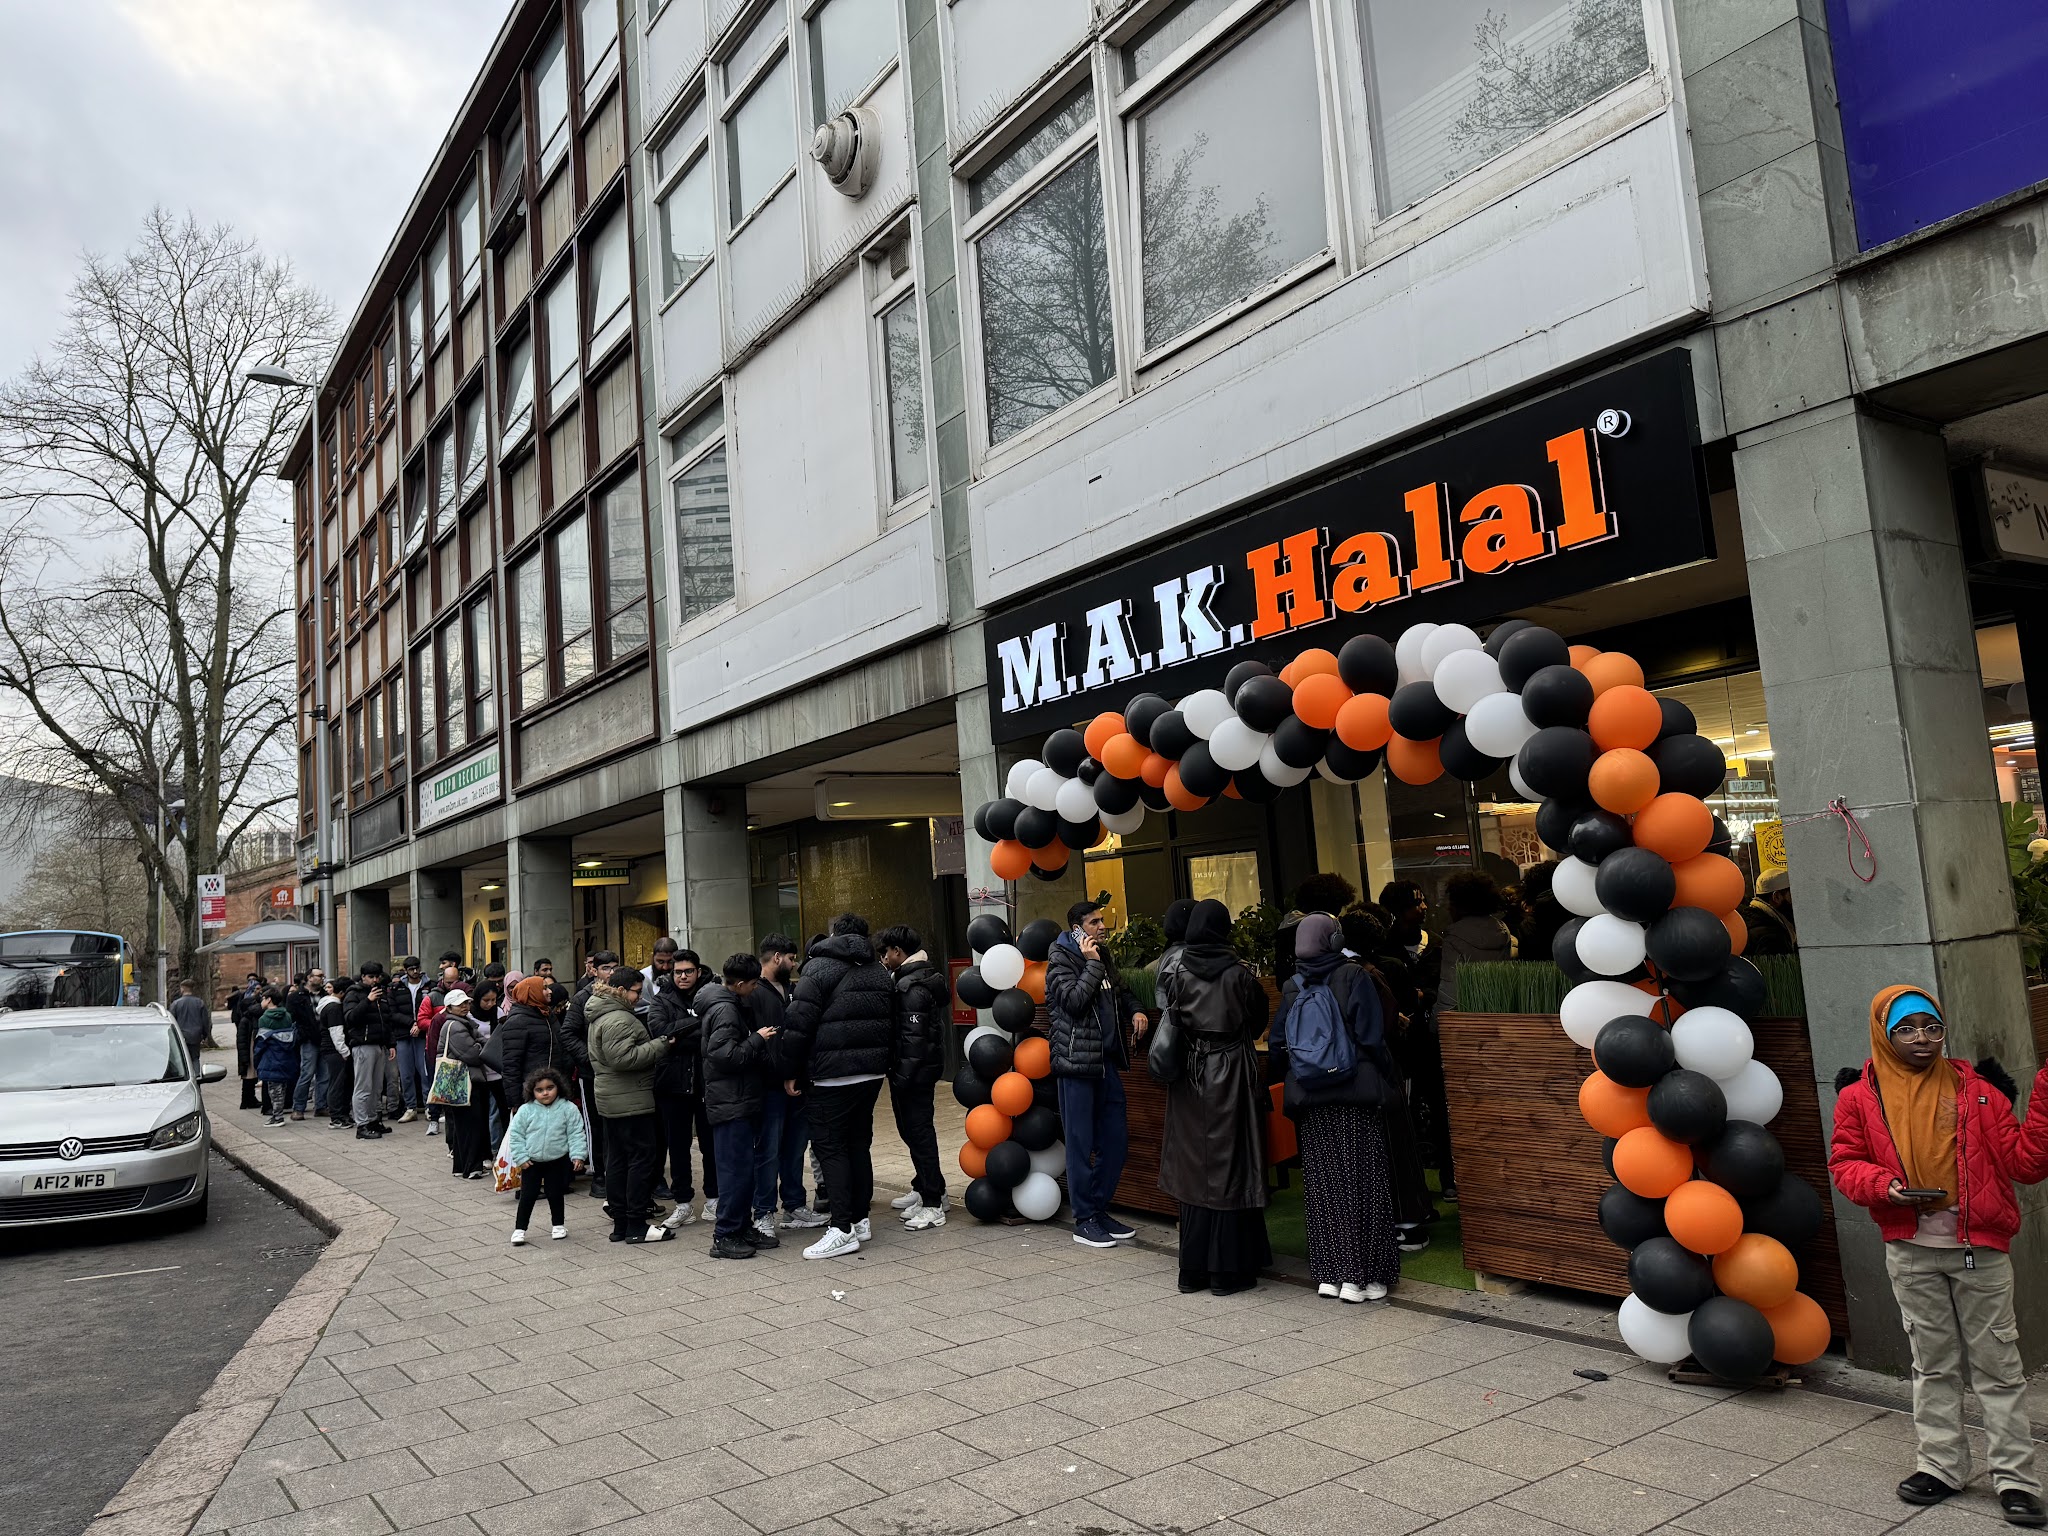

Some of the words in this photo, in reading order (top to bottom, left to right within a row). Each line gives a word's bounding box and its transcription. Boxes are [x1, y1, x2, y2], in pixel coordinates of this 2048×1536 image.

[997, 565, 1245, 713] M.A.K.
[1246, 428, 1612, 638] Halal
[33, 1175, 70, 1190] AF12
[74, 1174, 105, 1188] WFB
